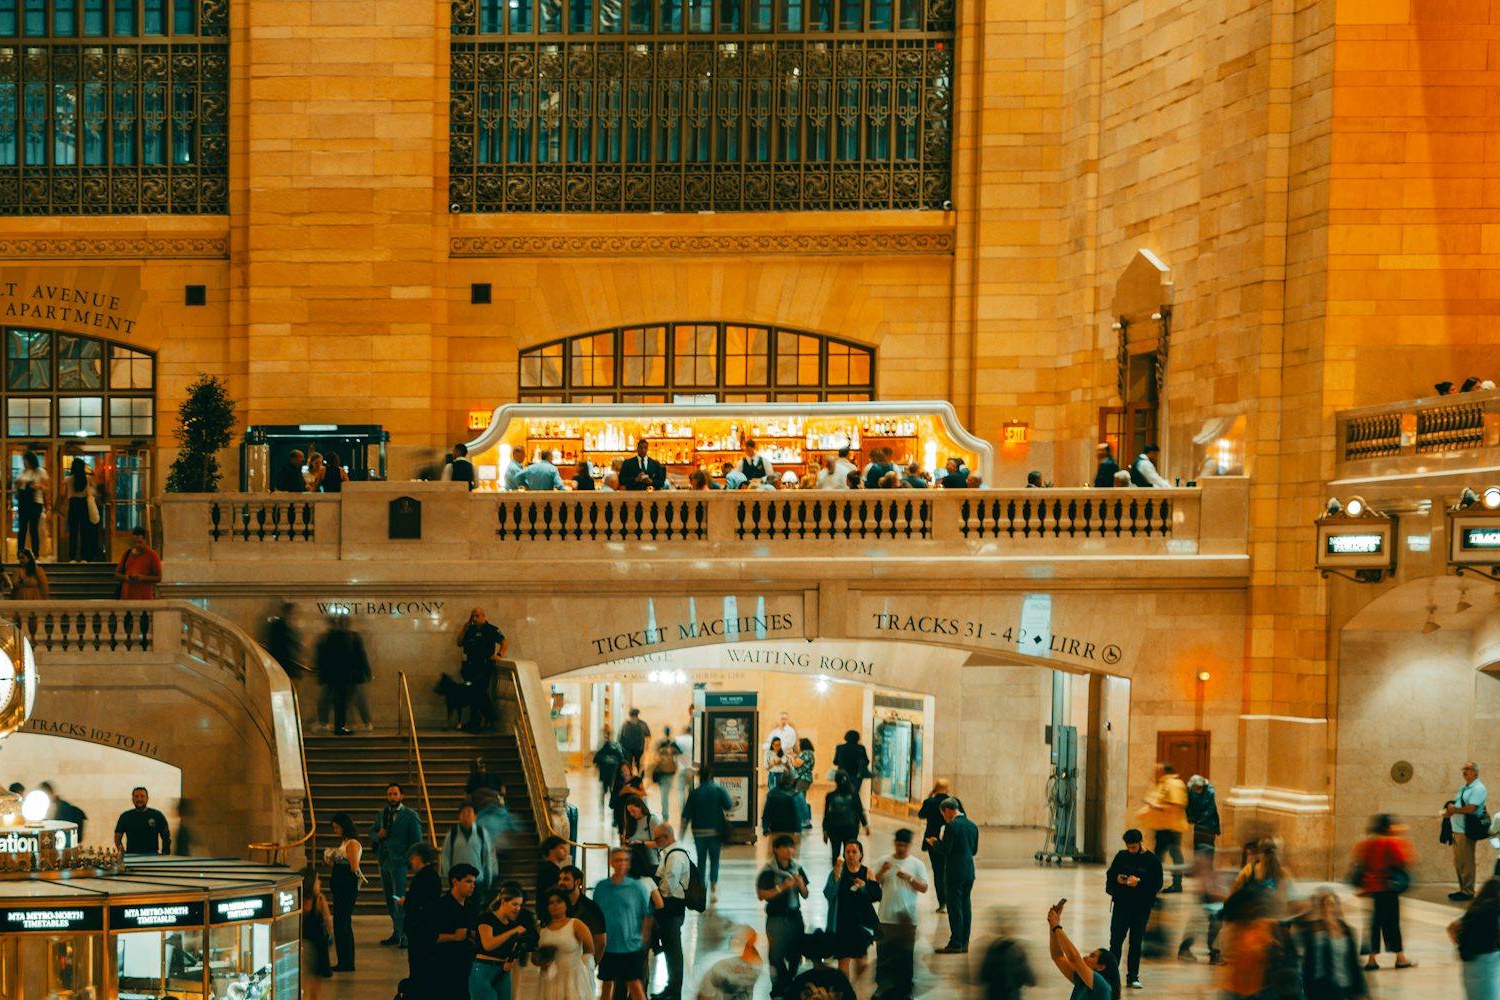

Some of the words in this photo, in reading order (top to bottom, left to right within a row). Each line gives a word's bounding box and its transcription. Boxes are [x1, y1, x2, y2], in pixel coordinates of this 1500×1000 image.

[32, 284, 120, 311] AVENUE
[5, 302, 136, 334] APARTMENT
[317, 602, 361, 615] WEST
[367, 602, 445, 615] BALCONY
[592, 627, 668, 655] TICKET
[678, 613, 793, 640] MACHINES
[872, 613, 959, 636] TRACKS
[964, 621, 983, 639] 31
[1002, 627, 1027, 645] 42
[1048, 634, 1097, 660] LIRR
[727, 648, 810, 667] WAITING
[820, 655, 875, 676] ROOM
[30, 718, 86, 736] TRACKS
[90, 728, 112, 743] 102
[115, 733, 135, 748] TO
[139, 740, 158, 755] 114
[7, 911, 25, 921] MTA
[26, 910, 84, 921] METRO-NORTH
[22, 919, 69, 928] TIMETABLES
